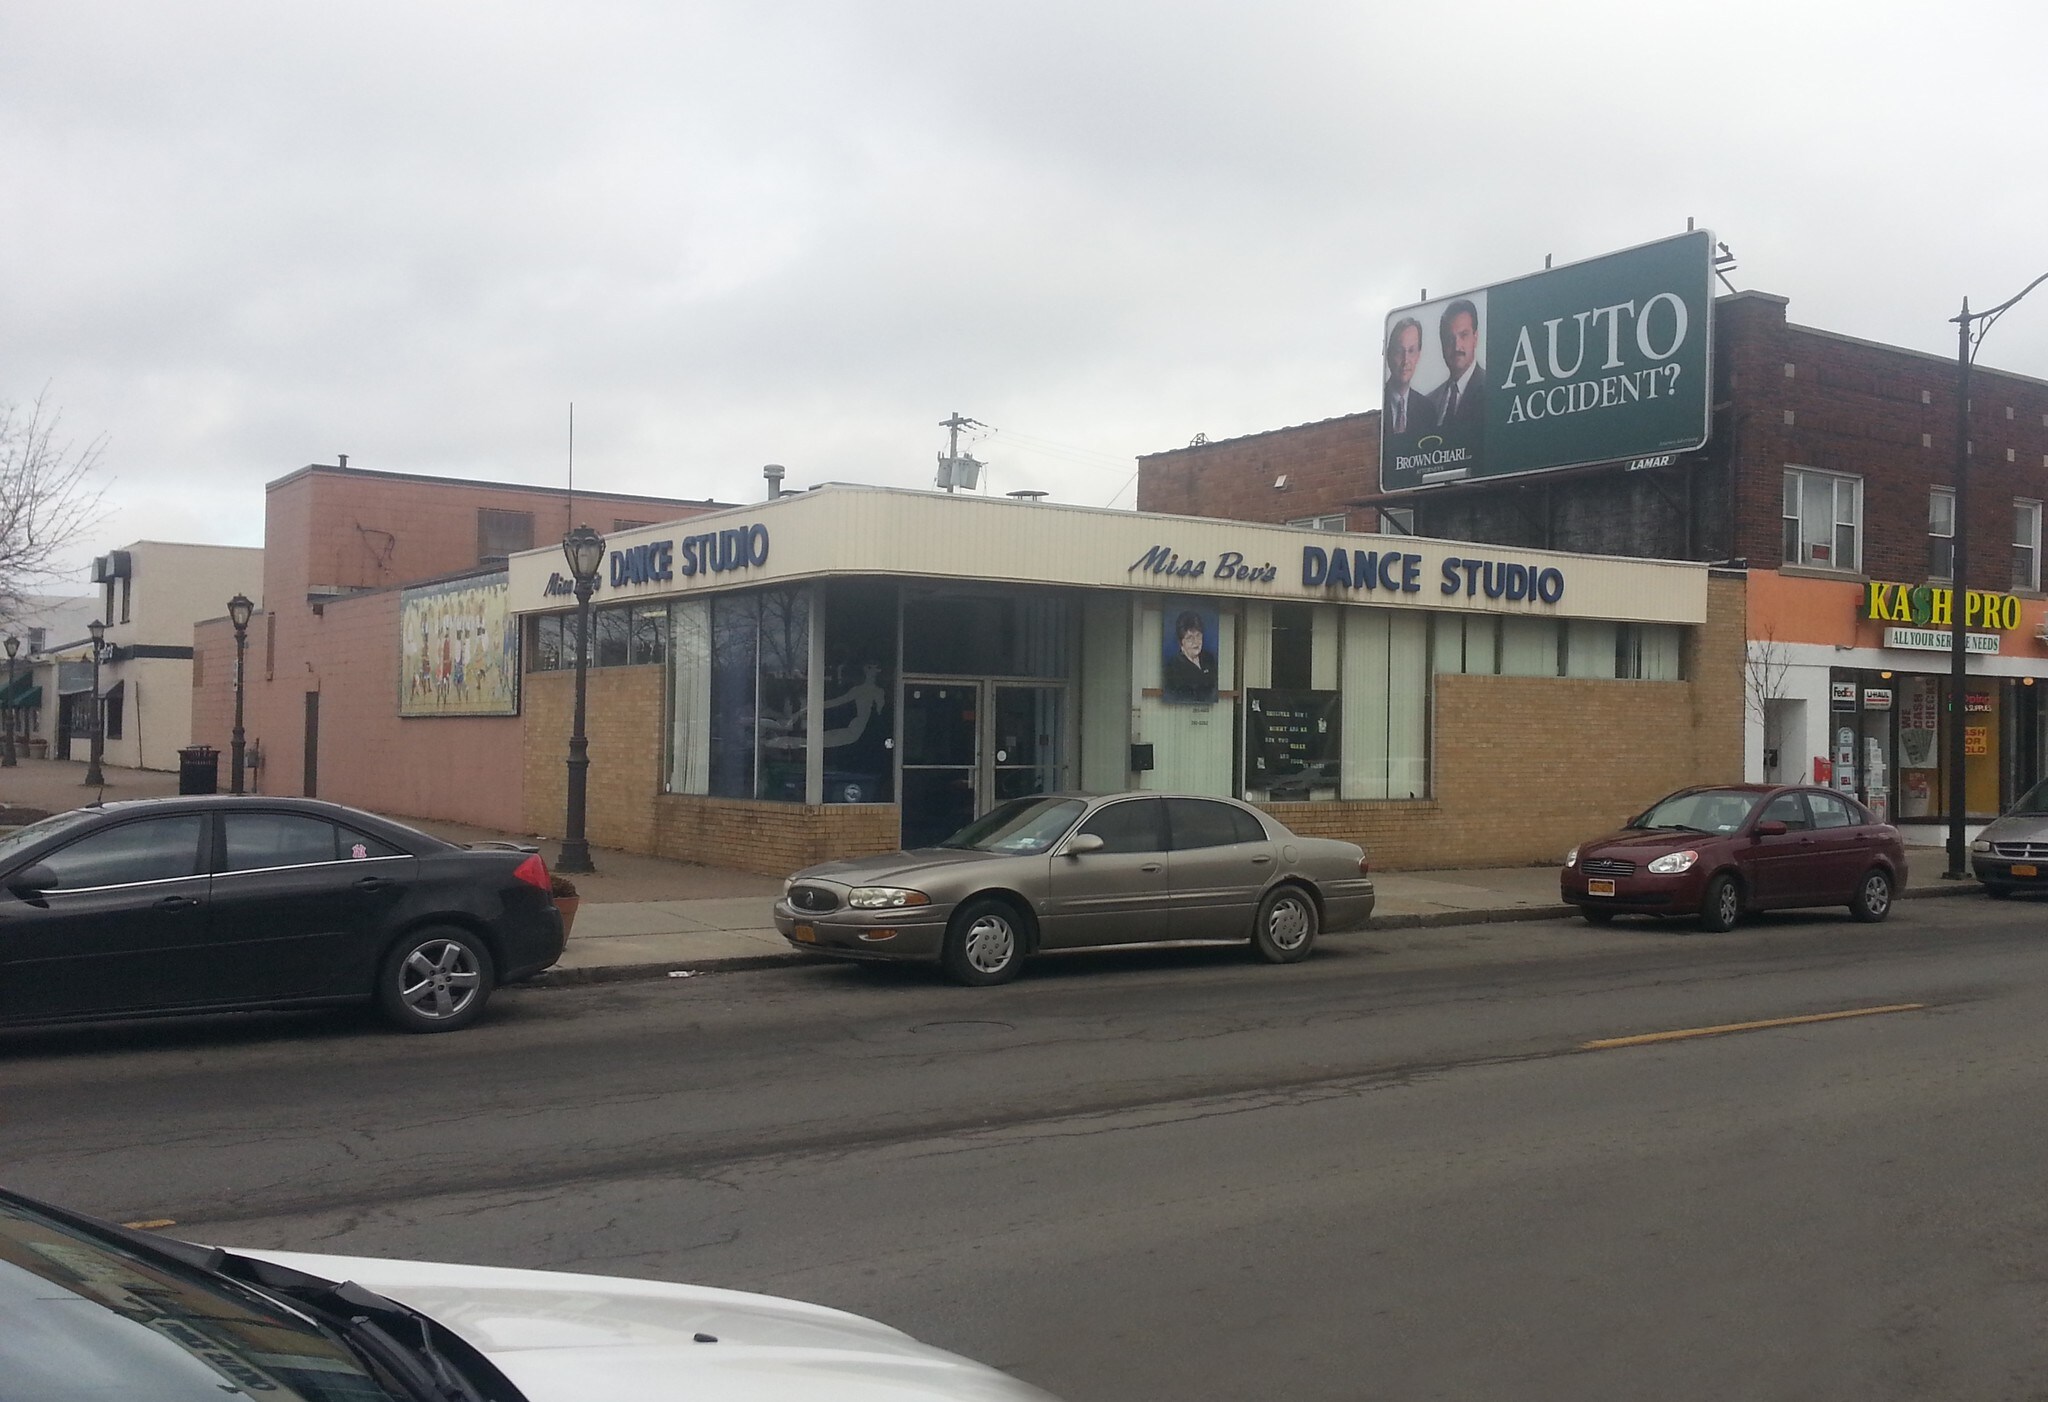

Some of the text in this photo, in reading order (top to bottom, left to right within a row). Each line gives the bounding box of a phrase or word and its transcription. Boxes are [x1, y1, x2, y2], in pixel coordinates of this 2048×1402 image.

[1501, 292, 1689, 390] AUTO
[1507, 363, 1682, 424] ACCIDENT?
[1395, 452, 1433, 471] BROWN
[1432, 447, 1467, 464] CHIARI
[1630, 455, 1670, 471] LAMAR
[610, 539, 673, 588] DANCE
[682, 523, 770, 577] STUDIO
[1128, 545, 1565, 604] Miss Bev's DANCE STUDIO
[1965, 591, 2022, 631] PRO
[1893, 630, 1999, 651] ALL YOUR SERE NEEDS
[1833, 686, 1855, 698] FedEx
[1913, 693, 1923, 729] CASH
